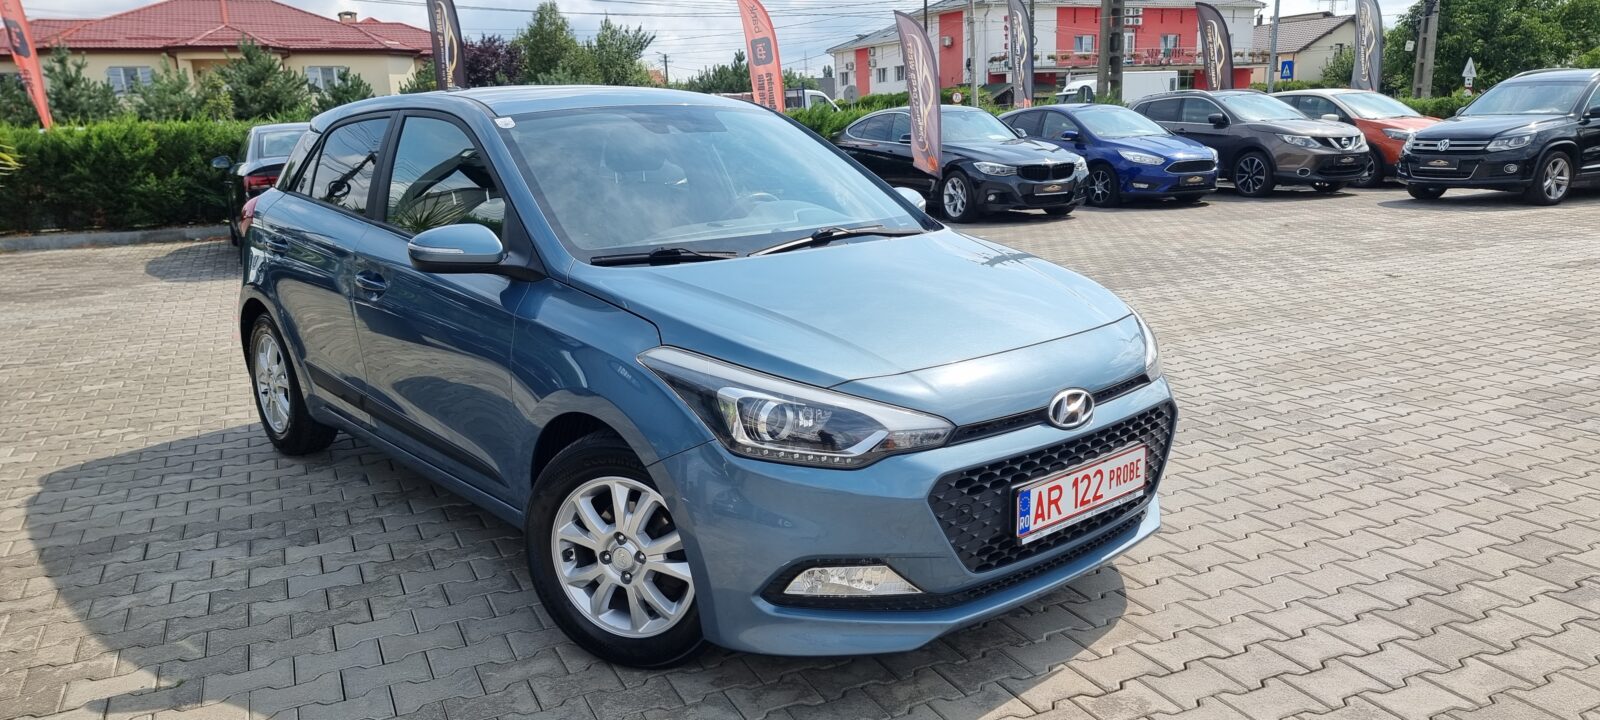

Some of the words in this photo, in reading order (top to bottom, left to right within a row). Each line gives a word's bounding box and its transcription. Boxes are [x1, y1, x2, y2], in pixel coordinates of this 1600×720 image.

[1033, 484, 1063, 526] AR
[1071, 468, 1104, 509] 122
[1108, 458, 1142, 490] PROBE
[1019, 514, 1031, 531] RO
